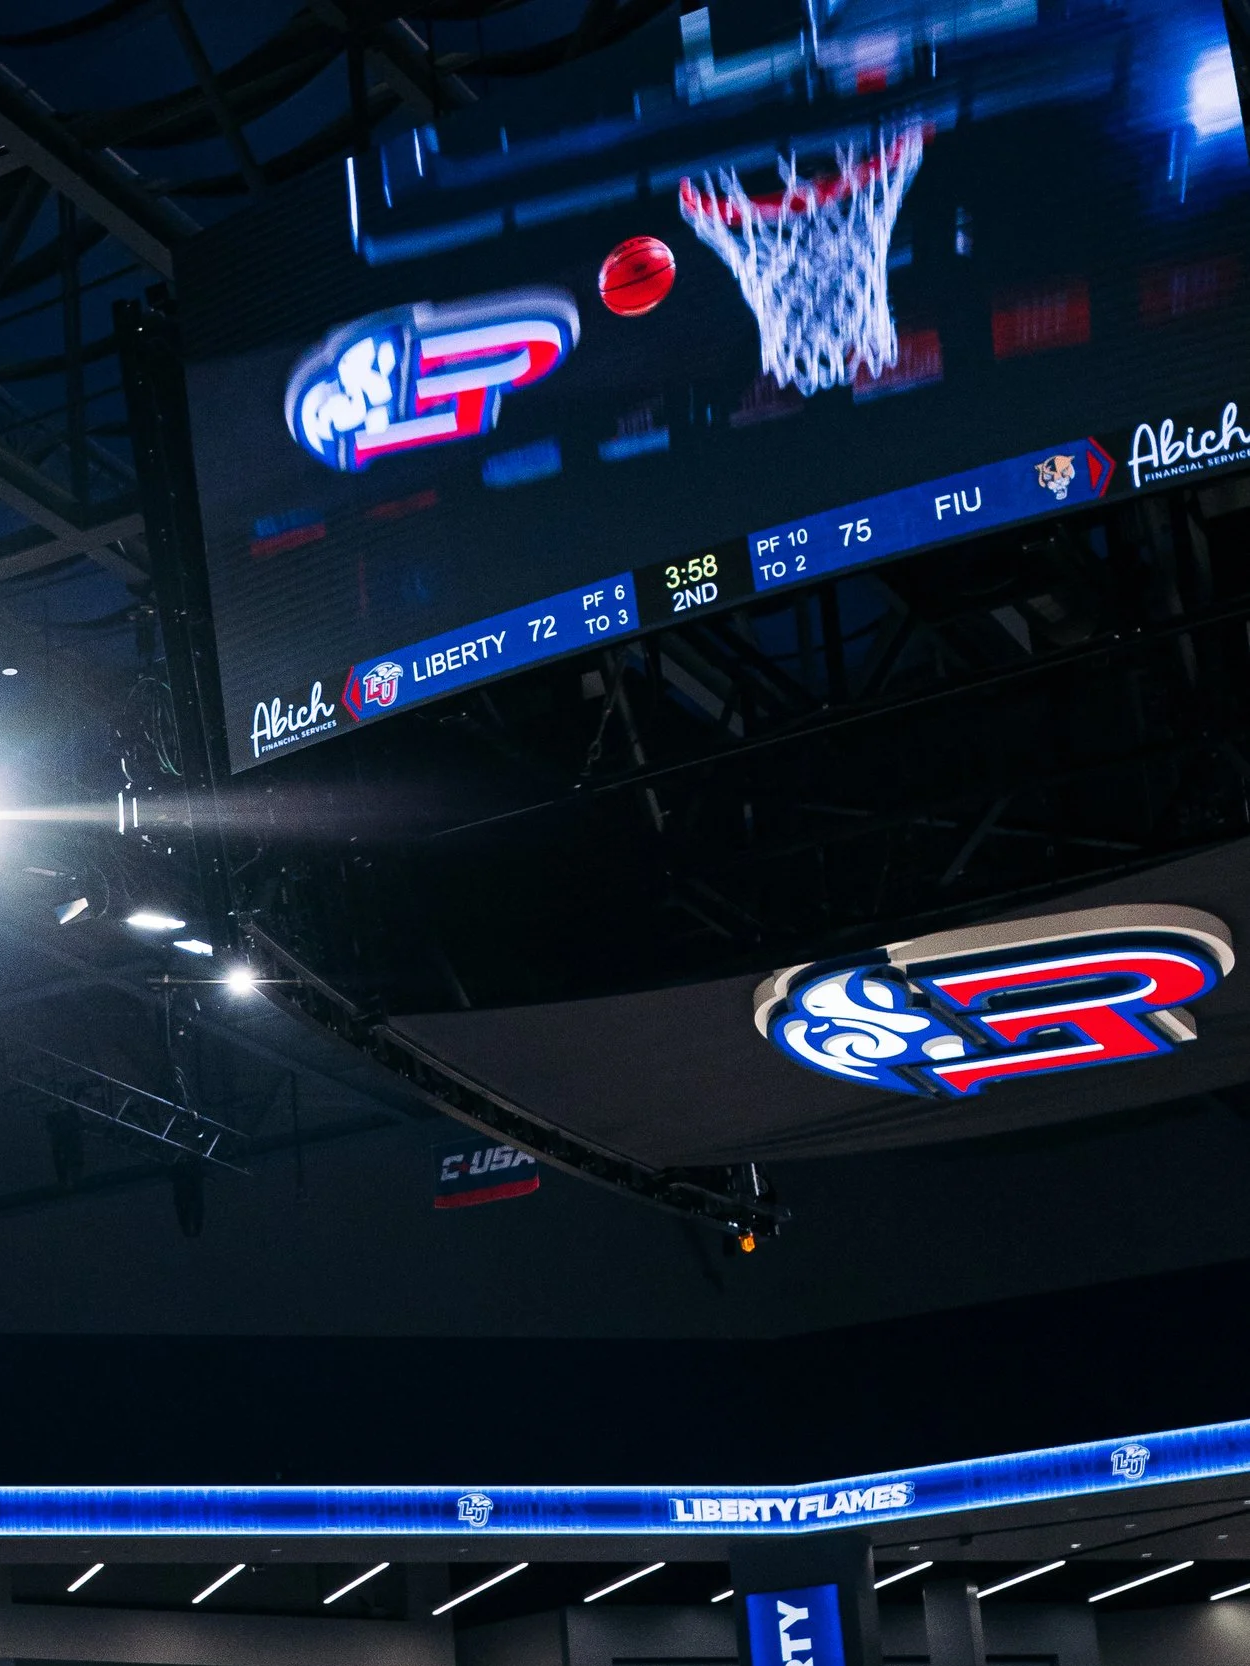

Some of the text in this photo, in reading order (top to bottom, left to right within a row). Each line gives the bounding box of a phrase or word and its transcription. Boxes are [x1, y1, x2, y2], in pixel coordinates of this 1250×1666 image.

[1128, 402, 1250, 488] Abich
[1145, 461, 1204, 483] FINANCIAL
[934, 487, 982, 520] FIU
[757, 528, 809, 557] PF 10
[839, 518, 872, 548] 75
[665, 554, 718, 590] 3:58
[759, 555, 807, 582] TO 2
[583, 584, 625, 611] PF 6
[672, 582, 719, 612] 2ND
[584, 608, 629, 635] TO 3
[412, 615, 557, 683] LIBERTY 72
[250, 681, 334, 758] Abich
[261, 720, 338, 753] FINANCIAL SERVICES
[670, 1482, 914, 1523] LIBERTY FLAMES
